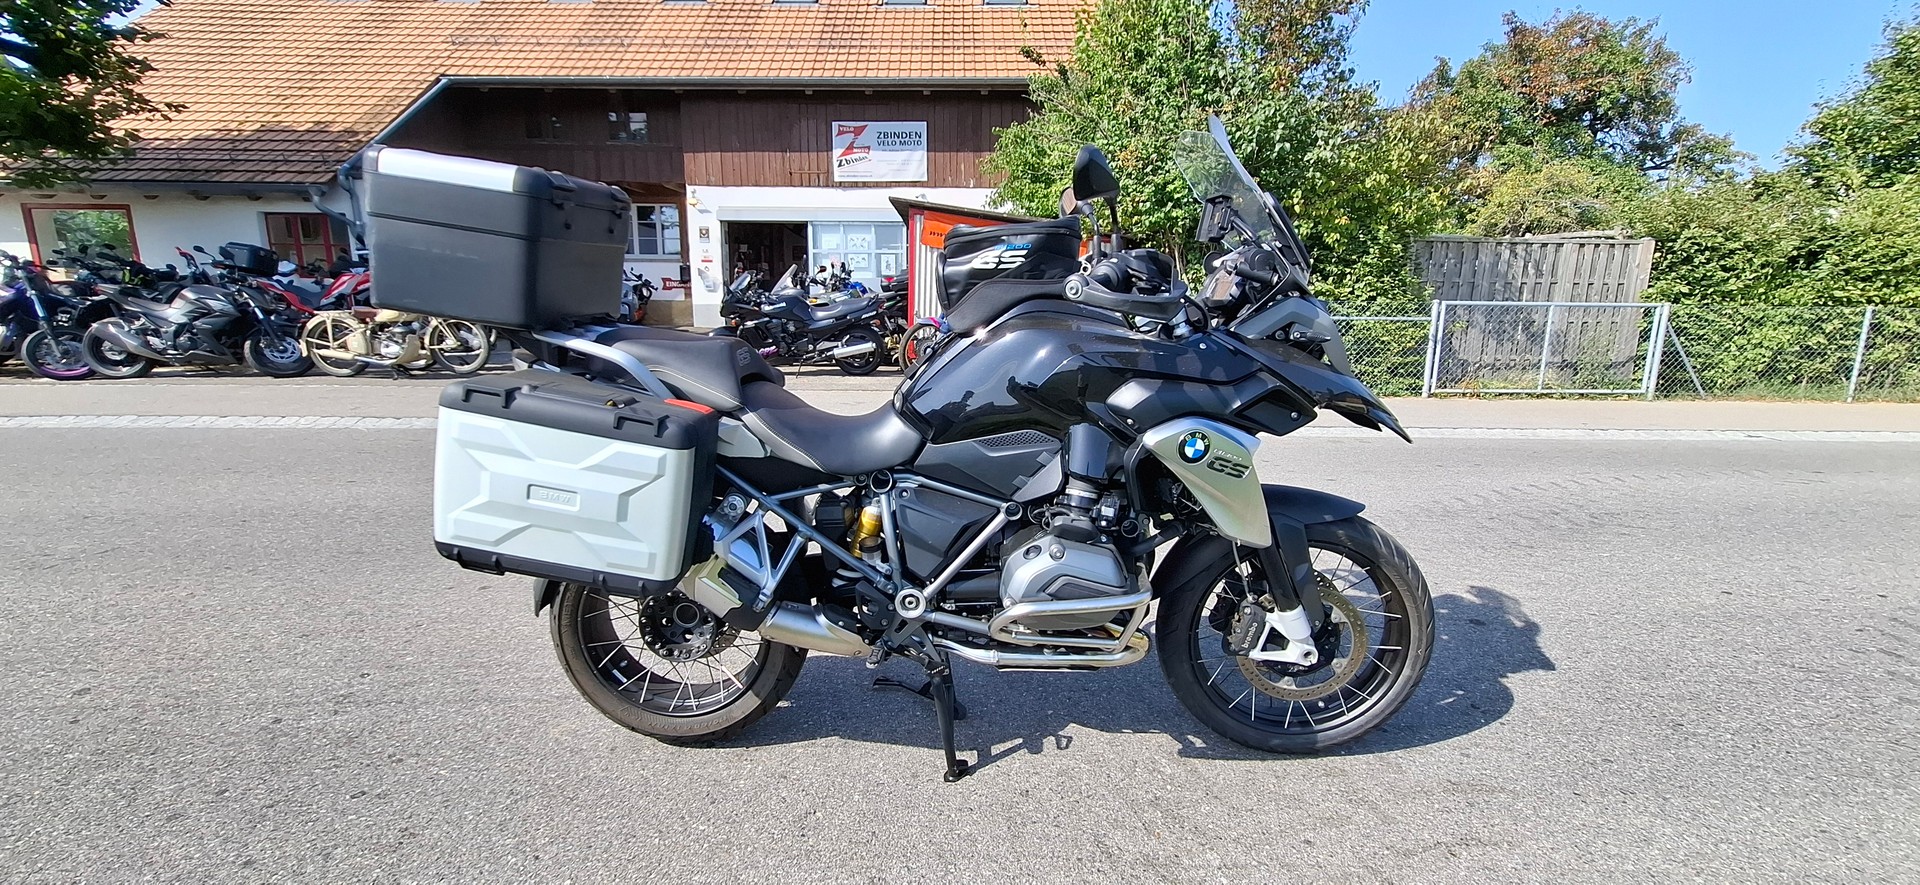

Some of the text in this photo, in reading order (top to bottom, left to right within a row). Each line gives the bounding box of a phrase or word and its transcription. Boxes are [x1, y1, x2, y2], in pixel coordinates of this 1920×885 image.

[876, 131, 922, 139] ZBINDEN
[836, 155, 869, 168] Zbinden
[972, 249, 1029, 269] GS
[1184, 432, 1210, 446] BMW
[1206, 456, 1252, 479] GS
[540, 490, 571, 504] BMW
[1241, 622, 1258, 649] brembo
